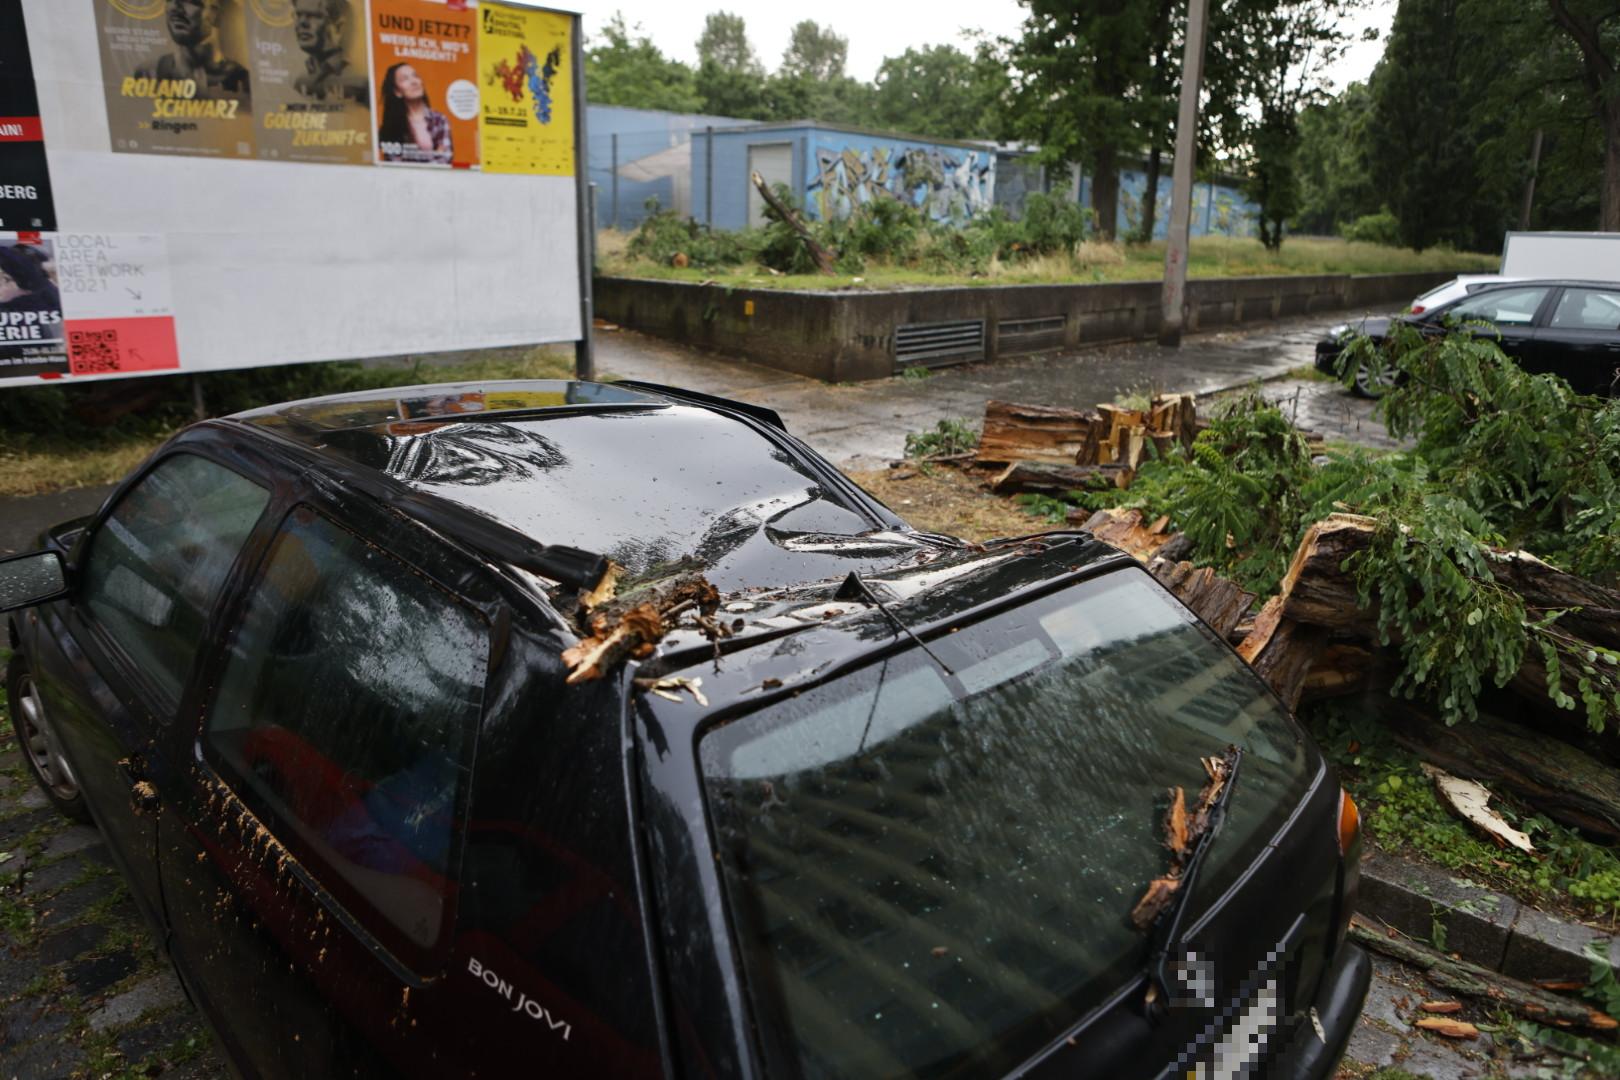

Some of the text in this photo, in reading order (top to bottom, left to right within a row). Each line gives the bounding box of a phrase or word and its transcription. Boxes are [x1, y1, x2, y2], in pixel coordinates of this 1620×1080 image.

[379, 13, 472, 40] UND JETZT?
[121, 77, 197, 99] ROLAND
[151, 98, 240, 119] SCHWARZ
[151, 119, 198, 135] Ringen
[264, 112, 328, 130] GOLDENE
[56, 233, 119, 249] LOCAL
[60, 249, 107, 264] AREA
[60, 263, 145, 279] NETWORK
[63, 278, 109, 293] 2021
[467, 957, 572, 1041] BON JOVI
